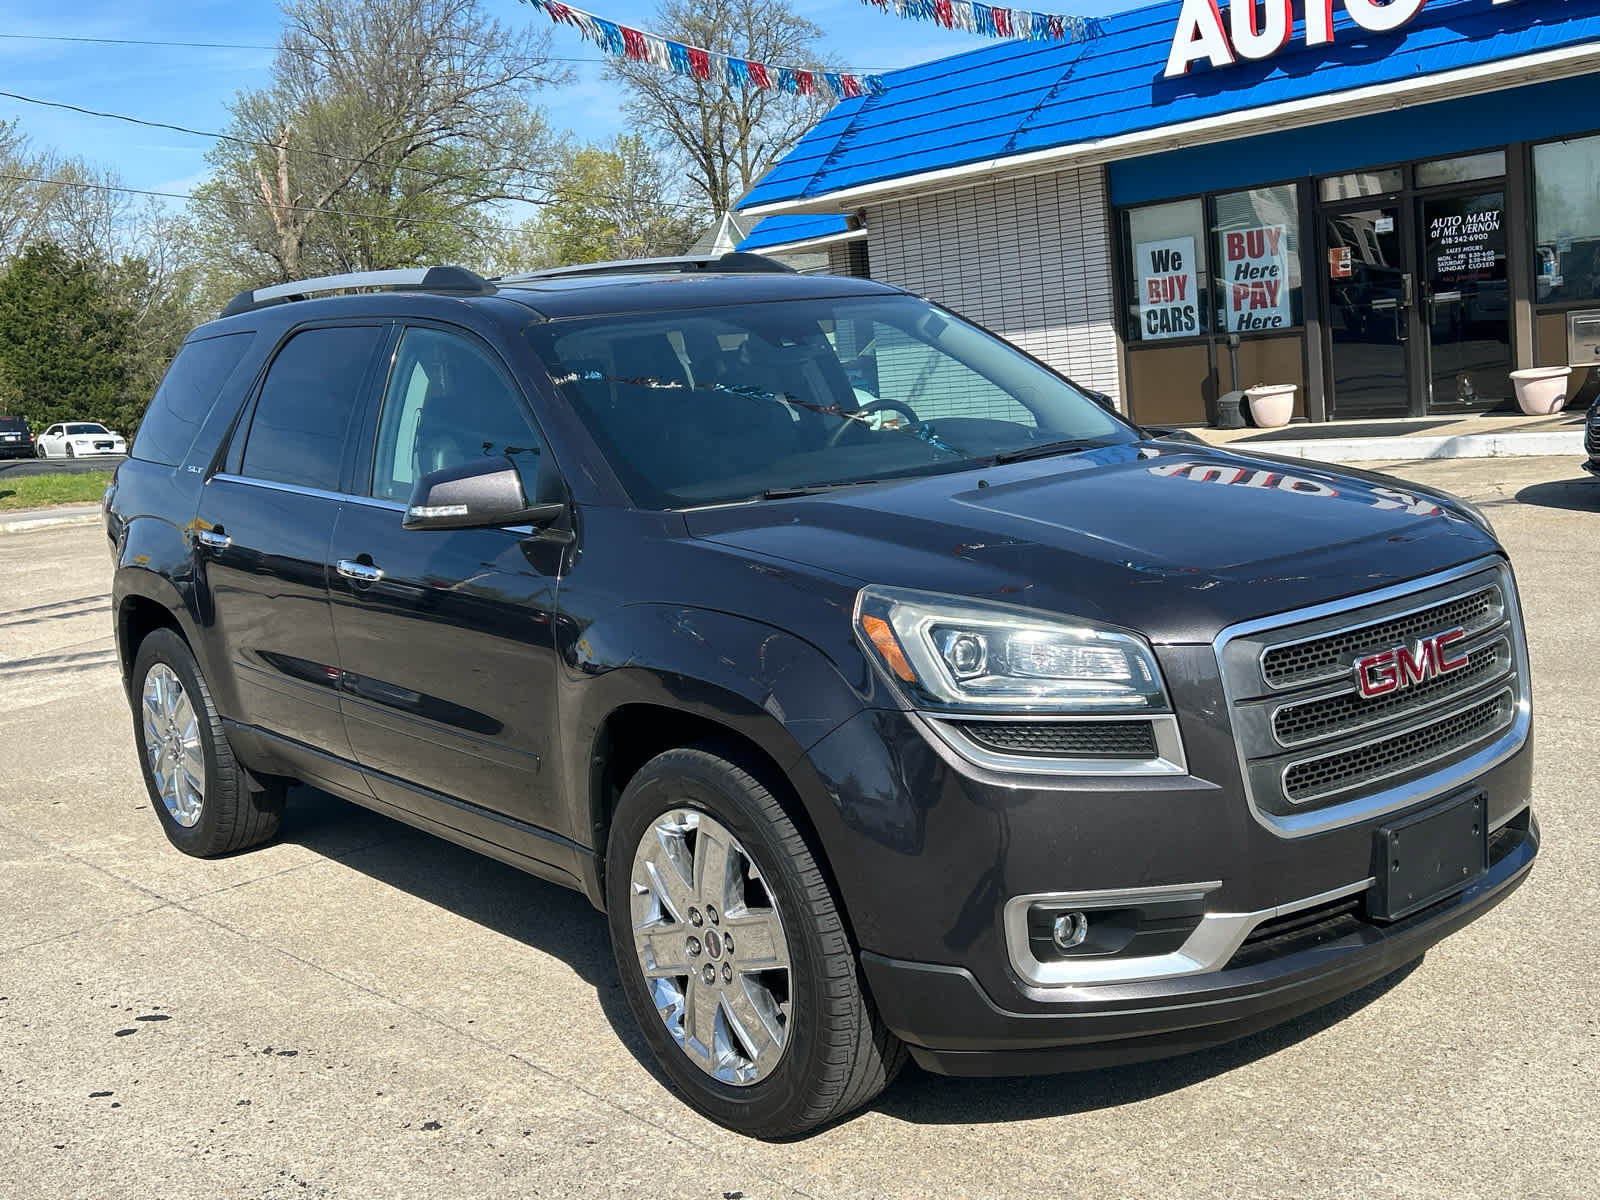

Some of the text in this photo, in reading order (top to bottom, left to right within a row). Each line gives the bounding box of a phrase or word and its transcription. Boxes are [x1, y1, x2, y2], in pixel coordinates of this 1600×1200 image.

[1430, 210, 1500, 229] AUTO MART
[1431, 220, 1500, 238] of MT. VERNON
[1226, 227, 1282, 261] BUY
[1441, 232, 1489, 245] 618-242-6900
[1151, 249, 1183, 273] We
[1437, 261, 1495, 273] SUNDAY CLOSED
[1234, 263, 1281, 281] Here
[1147, 274, 1188, 304] BUY
[1232, 279, 1281, 312] PAY
[1146, 305, 1195, 335] CARS
[1236, 312, 1283, 330] Here
[1353, 625, 1469, 699] GMC
